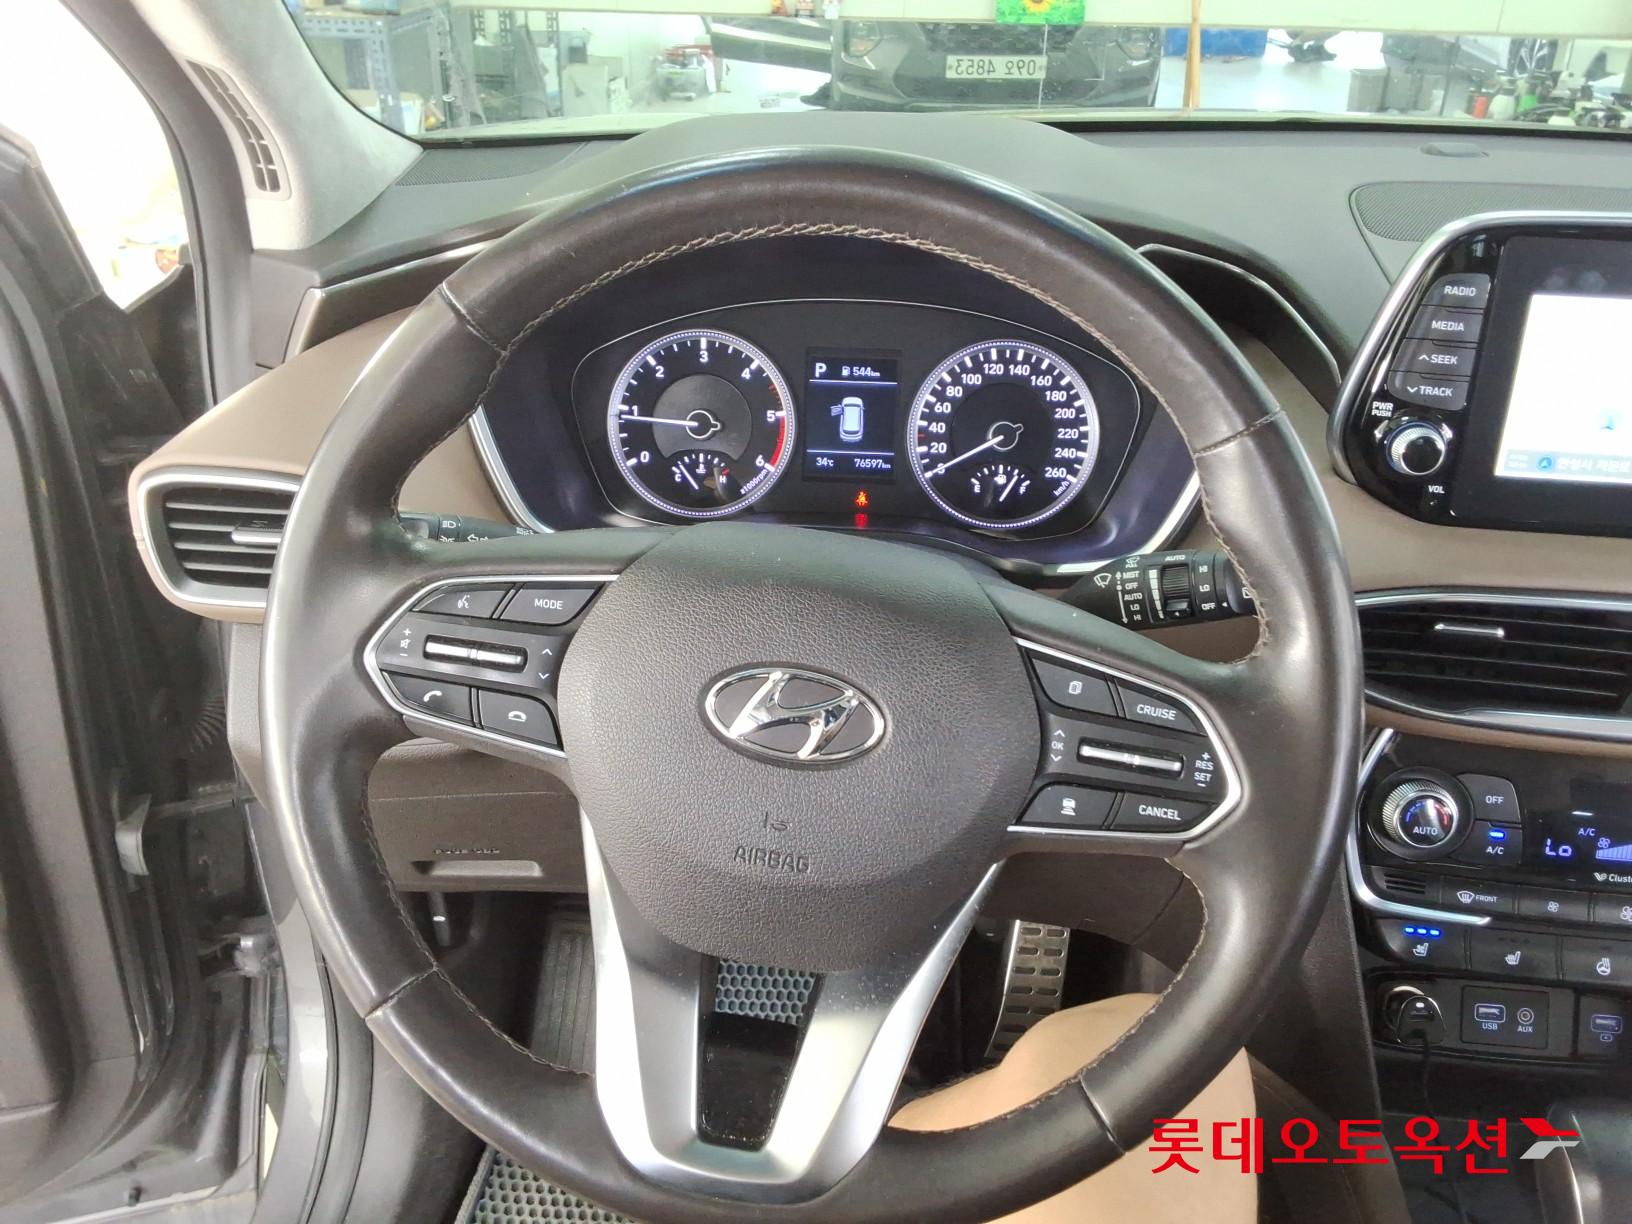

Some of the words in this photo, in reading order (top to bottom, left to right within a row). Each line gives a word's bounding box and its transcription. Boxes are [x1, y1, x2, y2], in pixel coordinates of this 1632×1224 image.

[1443, 285, 1476, 296] RADIO
[1431, 320, 1465, 332] MEDIA
[700, 350, 708, 362] 3
[1431, 354, 1458, 365] SEEK
[656, 366, 664, 378] 2
[741, 368, 750, 380] 4
[815, 362, 827, 378] P
[983, 363, 1004, 374] 120
[1008, 364, 1030, 376] 140
[961, 374, 982, 384] 100
[1030, 375, 1052, 386] 160
[946, 386, 963, 398] 80
[1045, 390, 1067, 402] 180
[1419, 386, 1454, 397] TRACK
[632, 405, 638, 416] 1
[934, 402, 951, 414] 60
[1372, 401, 1394, 412] PWR
[766, 410, 776, 422] 5
[1054, 408, 1076, 419] 200
[1371, 409, 1392, 418] PUSH
[928, 422, 946, 434] 40
[1056, 428, 1078, 439] 220
[930, 442, 947, 454] 20
[1054, 447, 1076, 458] 240
[640, 450, 650, 462] 0
[756, 454, 764, 466] 6
[674, 474, 682, 482] C
[1044, 467, 1067, 478] 260
[719, 476, 726, 484] H
[974, 484, 981, 494] E
[1019, 486, 1026, 495] F
[1053, 480, 1070, 497] km/h
[1428, 484, 1446, 494] VOL
[1122, 570, 1141, 579] MIST
[1124, 582, 1139, 590] OFF
[1200, 584, 1210, 592] LO
[534, 598, 564, 610] MODE
[1201, 602, 1216, 610] OFF
[1136, 703, 1177, 721] CRUISE
[1051, 740, 1064, 750] OK
[1195, 760, 1214, 771] RES
[1194, 772, 1212, 782] SET
[1485, 795, 1504, 804] OFF
[1138, 804, 1182, 821] CANCEL
[1412, 826, 1438, 836] AUTO
[1578, 828, 1596, 836] A/C
[1486, 846, 1504, 855] A/C
[733, 845, 810, 874] AIRBAG
[1608, 873, 1632, 884] Clust
[1476, 894, 1498, 903] FRONT
[1482, 1022, 1498, 1030] USB
